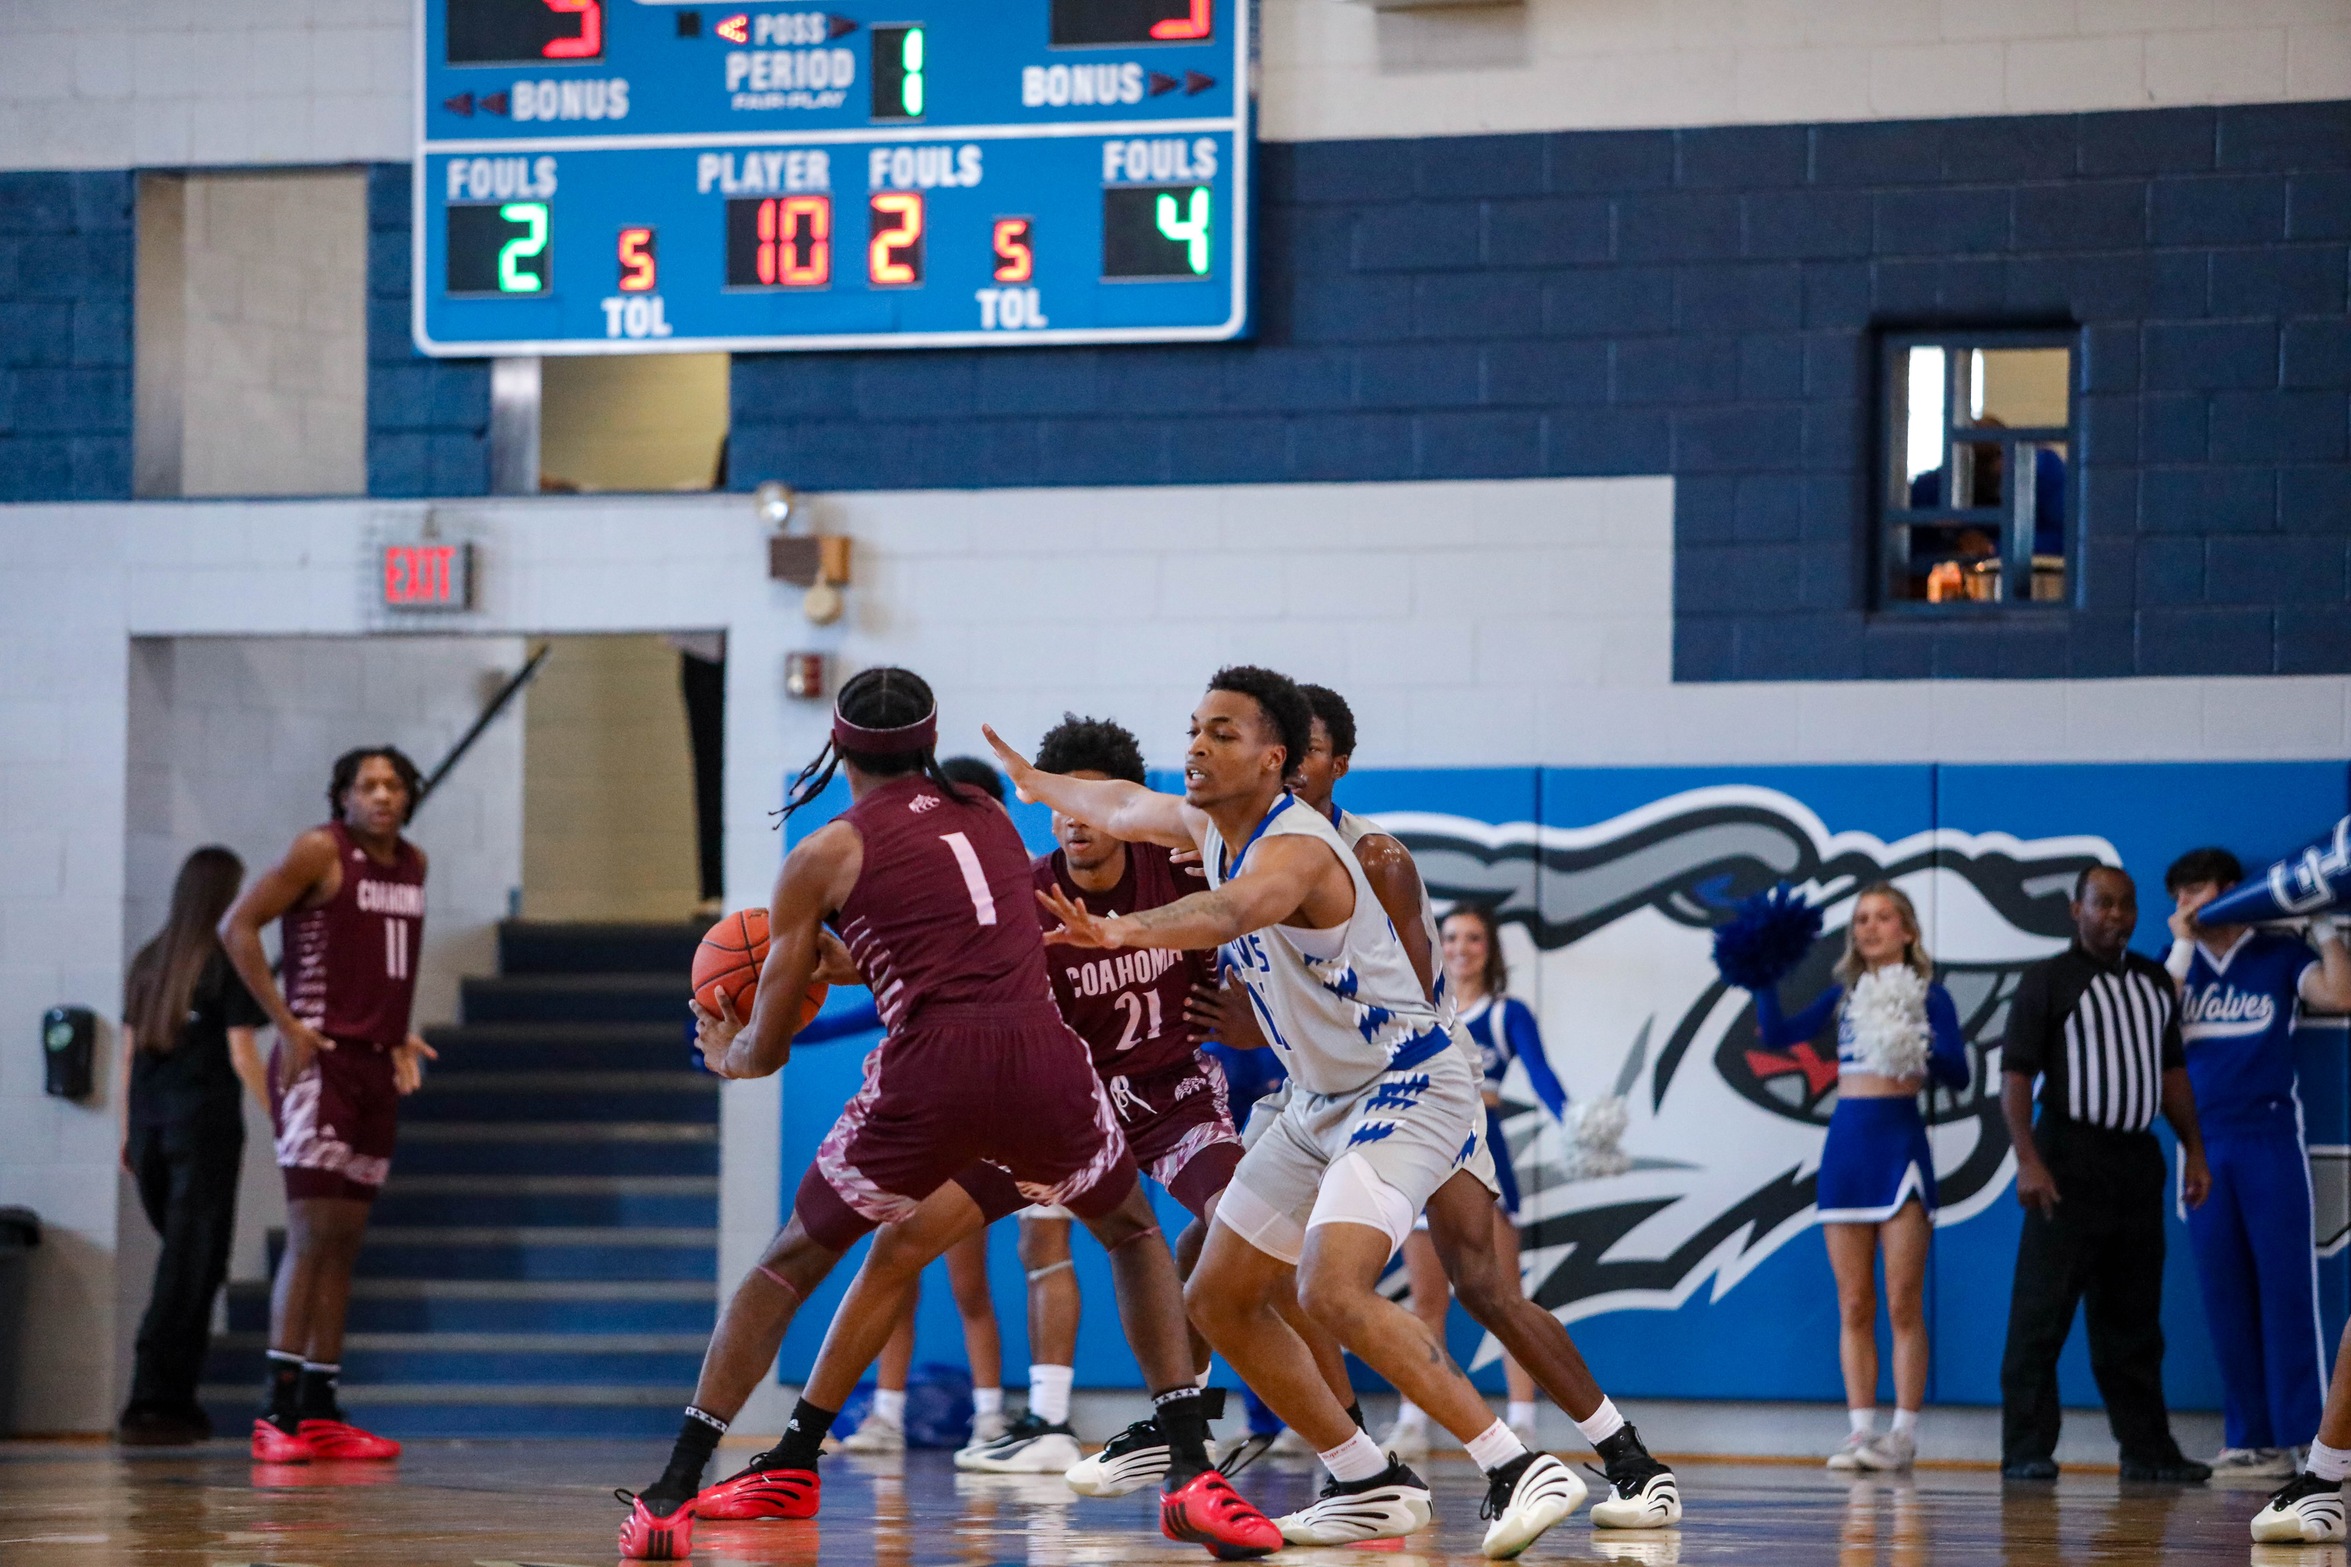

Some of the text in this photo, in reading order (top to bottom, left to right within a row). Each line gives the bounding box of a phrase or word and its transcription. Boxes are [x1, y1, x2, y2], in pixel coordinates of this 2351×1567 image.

[754, 13, 826, 45] POSS
[511, 77, 630, 122] BONUS
[725, 49, 855, 91] PERIOD
[902, 27, 923, 117] 1
[1021, 61, 1143, 107] BONUS
[446, 156, 558, 199] FOULS
[697, 144, 983, 194] PLAYER FOULS
[1102, 138, 1218, 181] FOULS
[498, 202, 549, 293] 2
[618, 228, 655, 291] 5
[757, 196, 830, 285] 10
[869, 192, 922, 283] 2
[993, 219, 1031, 282] 5
[1155, 185, 1209, 275] 4
[601, 295, 673, 338] TOL
[975, 287, 1049, 329] TOL
[384, 545, 457, 604] EXIT
[938, 831, 997, 926] 1
[385, 917, 408, 979] 11
[1114, 987, 1163, 1051] 21
[2182, 982, 2275, 1021] Wolves
